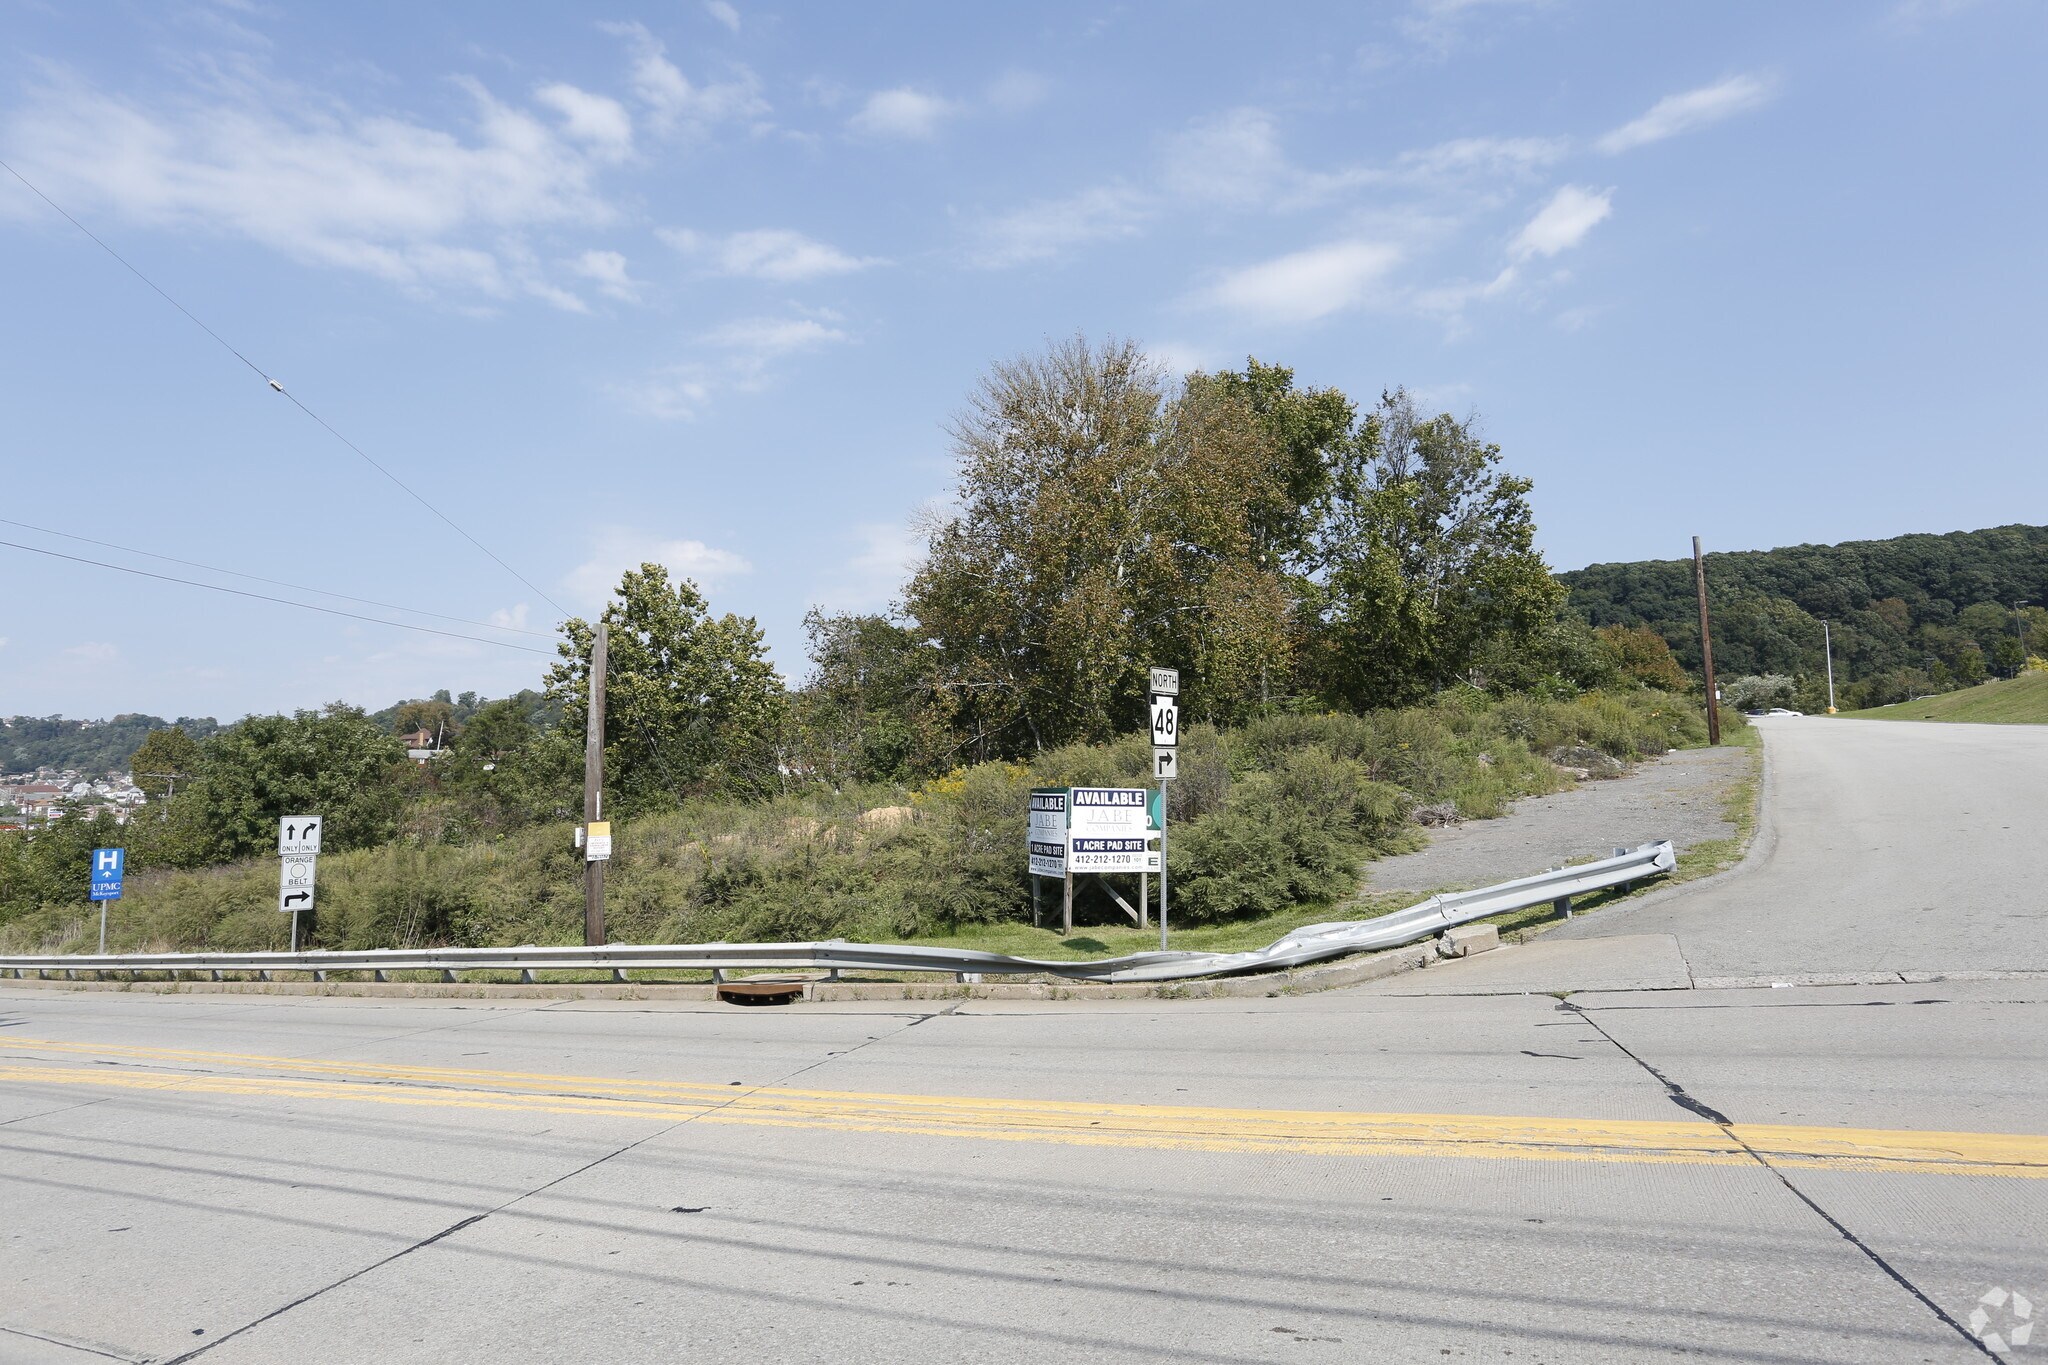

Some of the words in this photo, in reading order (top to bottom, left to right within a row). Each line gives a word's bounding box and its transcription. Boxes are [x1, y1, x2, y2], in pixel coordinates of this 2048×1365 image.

[1152, 673, 1177, 689] NORTH
[1154, 708, 1174, 735] 48
[1031, 797, 1064, 810] AVAILABLE
[1075, 791, 1143, 805] AVAILABLE
[1035, 813, 1058, 827] JABE
[1086, 808, 1132, 822] JABE
[1086, 825, 1132, 833] COMPANIES
[1031, 844, 1034, 852] 1
[1034, 845, 1044, 854] ACRE
[1044, 845, 1053, 855] PAD
[1053, 846, 1063, 856] SITE
[1075, 841, 1080, 850] 1
[1083, 841, 1105, 850] ACRE
[1107, 841, 1123, 850] PAD
[1124, 841, 1142, 850] SITE
[98, 851, 118, 870] H
[284, 856, 313, 864] ORANGE
[1075, 855, 1131, 863] 412-212-1270
[92, 882, 121, 892] UPMC
